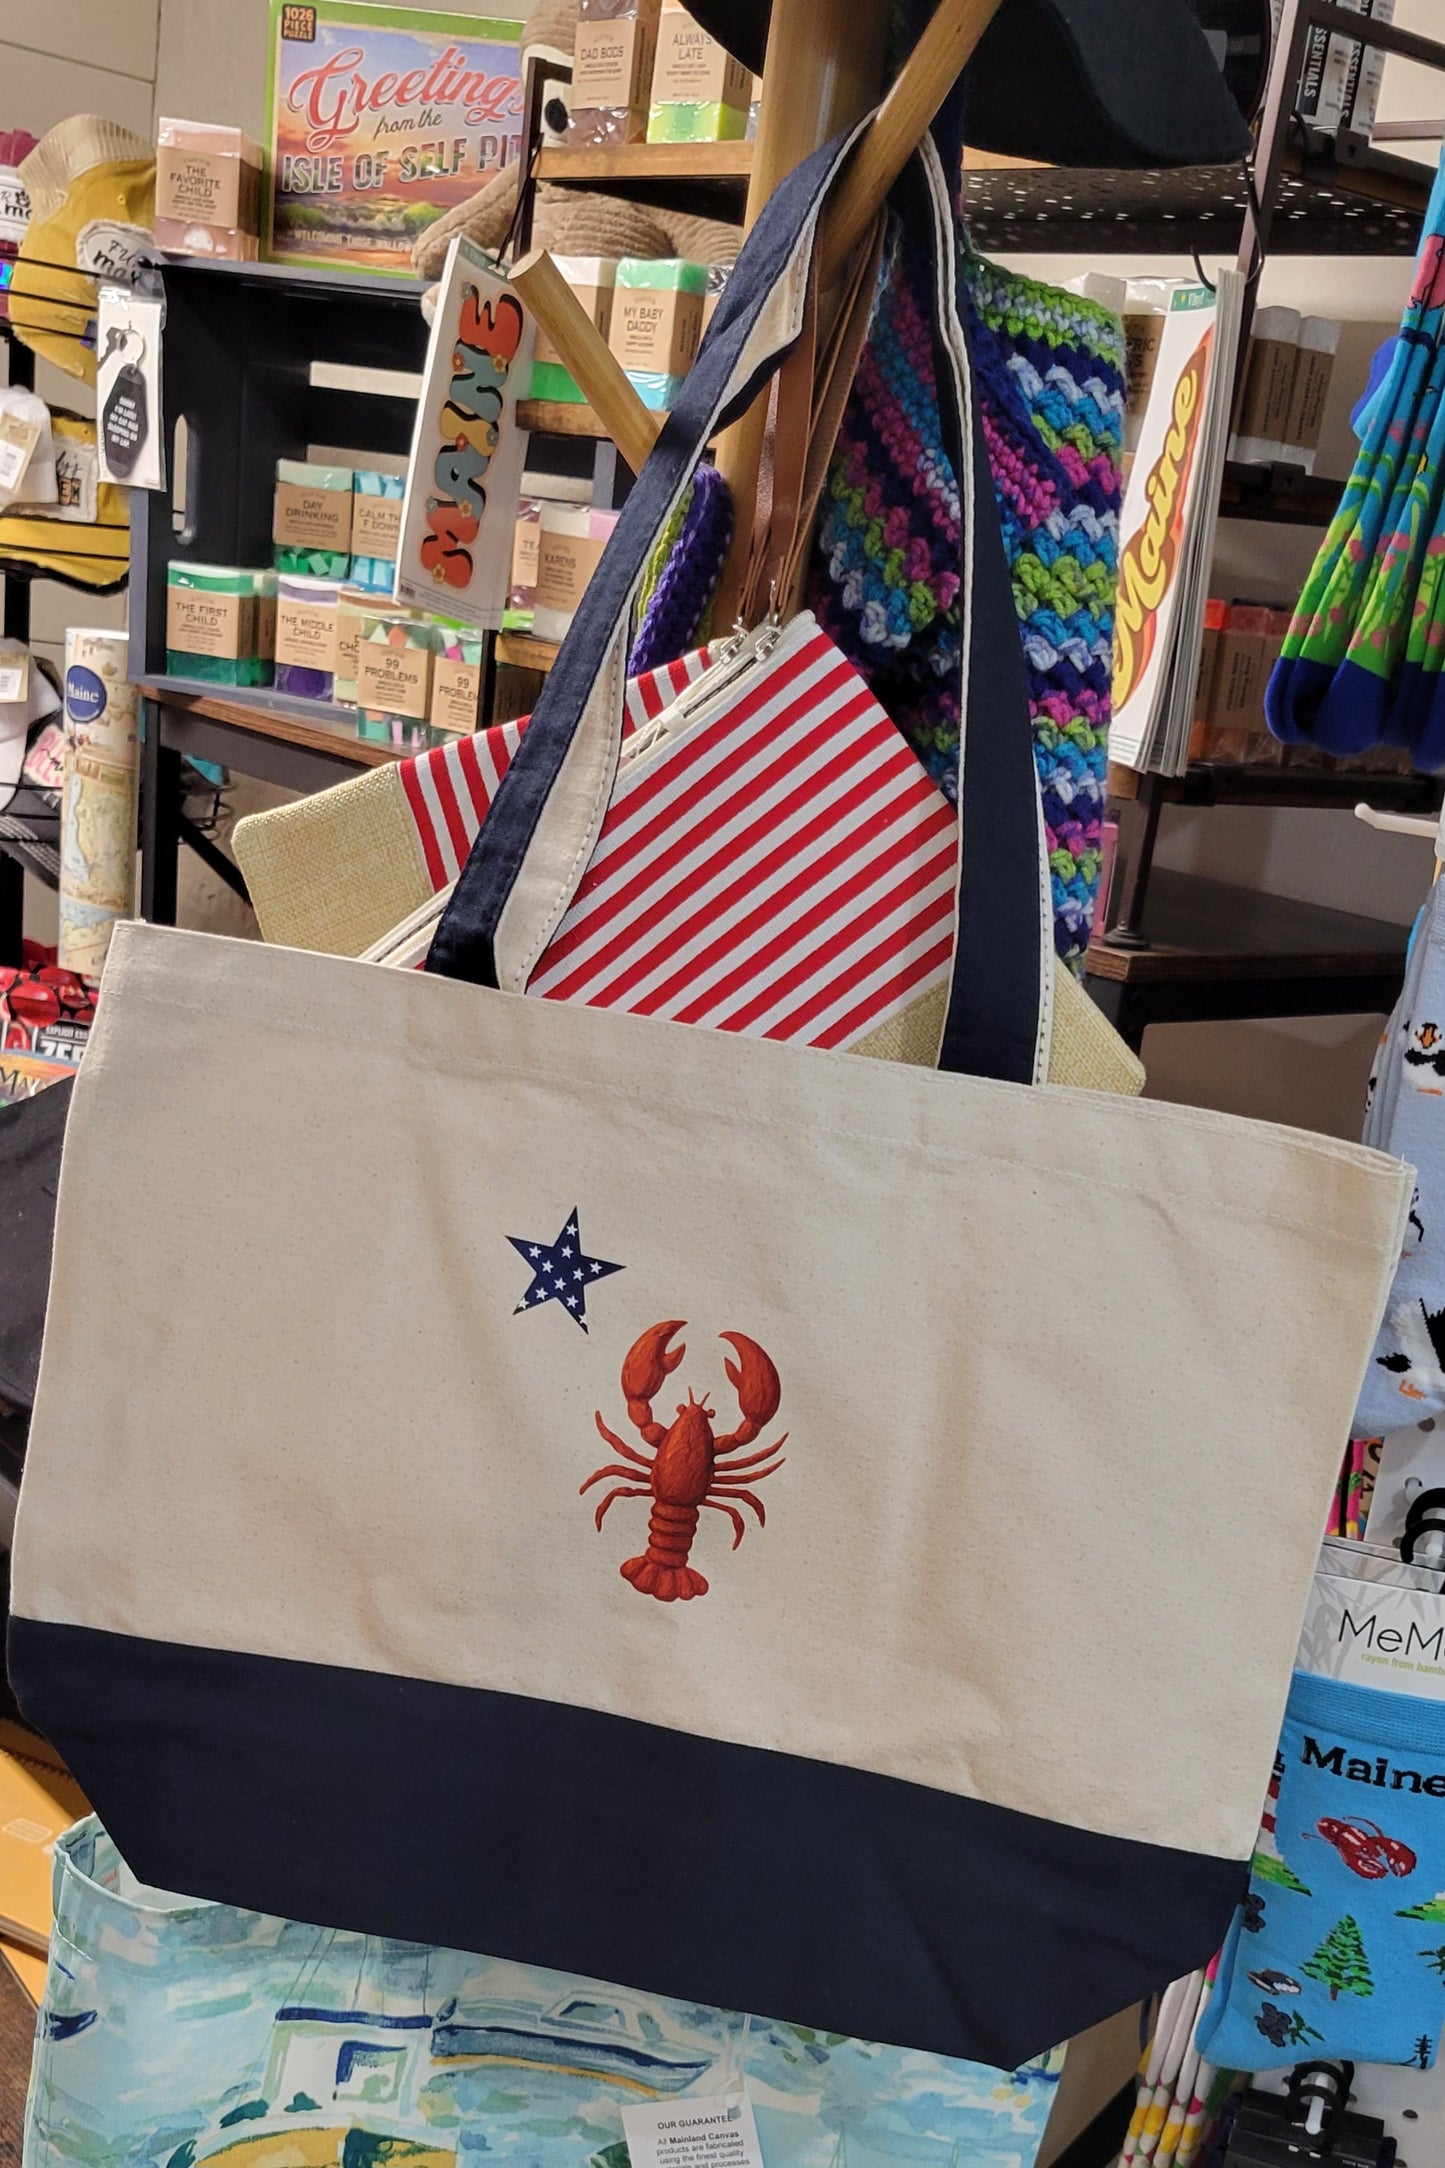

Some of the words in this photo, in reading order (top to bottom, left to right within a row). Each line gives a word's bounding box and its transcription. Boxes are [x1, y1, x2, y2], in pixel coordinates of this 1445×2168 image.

[285, 6, 314, 20] 1026
[284, 19, 313, 31] PIECE
[283, 30, 313, 40] PUZZLE
[672, 33, 713, 46] ALWAYS
[581, 48, 598, 60] DAD
[601, 46, 624, 58] BODS
[678, 48, 704, 60] LATE
[1303, 27, 1328, 98] SSENTIALS
[373, 116, 415, 141] from
[417, 109, 443, 129] the
[283, 155, 342, 193] ISLE
[353, 151, 389, 189] OF
[400, 138, 467, 182] SELF
[479, 134, 522, 170] PIT
[186, 165, 207, 177] THE
[170, 172, 221, 189] FAVORITE
[178, 184, 212, 198] CHILD
[623, 306, 637, 318] MY
[640, 307, 664, 320] BABY
[627, 320, 657, 333] DADDY
[303, 500, 323, 510] DAY
[286, 507, 339, 523] DRINKING
[359, 508, 386, 520] CALM
[388, 513, 400, 522] TH
[363, 519, 369, 527] F
[1112, 369, 1197, 711] Maine
[544, 553, 577, 569] KARENS
[176, 602, 196, 613] THE
[199, 605, 228, 618] FIRST
[186, 613, 218, 626] CHILD
[280, 615, 298, 626] THE
[300, 619, 334, 632] MIDDLE
[293, 627, 321, 640] CHILD
[385, 658, 400, 670] 99
[364, 666, 418, 685] PROBLEMS
[457, 676, 470, 689] 99
[68, 681, 100, 703] Maine
[1338, 1609, 1445, 1661] MeM
[1361, 1653, 1389, 1665] rayon
[1391, 1657, 1414, 1670] from
[1416, 1662, 1445, 1676] bamb
[1302, 1735, 1445, 1797] Maine
[657, 2121, 677, 2130] OUR
[669, 2134, 707, 2144] Mainland
[708, 2131, 739, 2140] Canvas
[657, 2146, 689, 2156] products
[692, 2144, 704, 2152] are
[705, 2139, 744, 2150] fabricated
[660, 2156, 680, 2164] using
[681, 2154, 694, 2162] the
[696, 2152, 717, 2161] finest
[718, 2149, 744, 2159] quality
